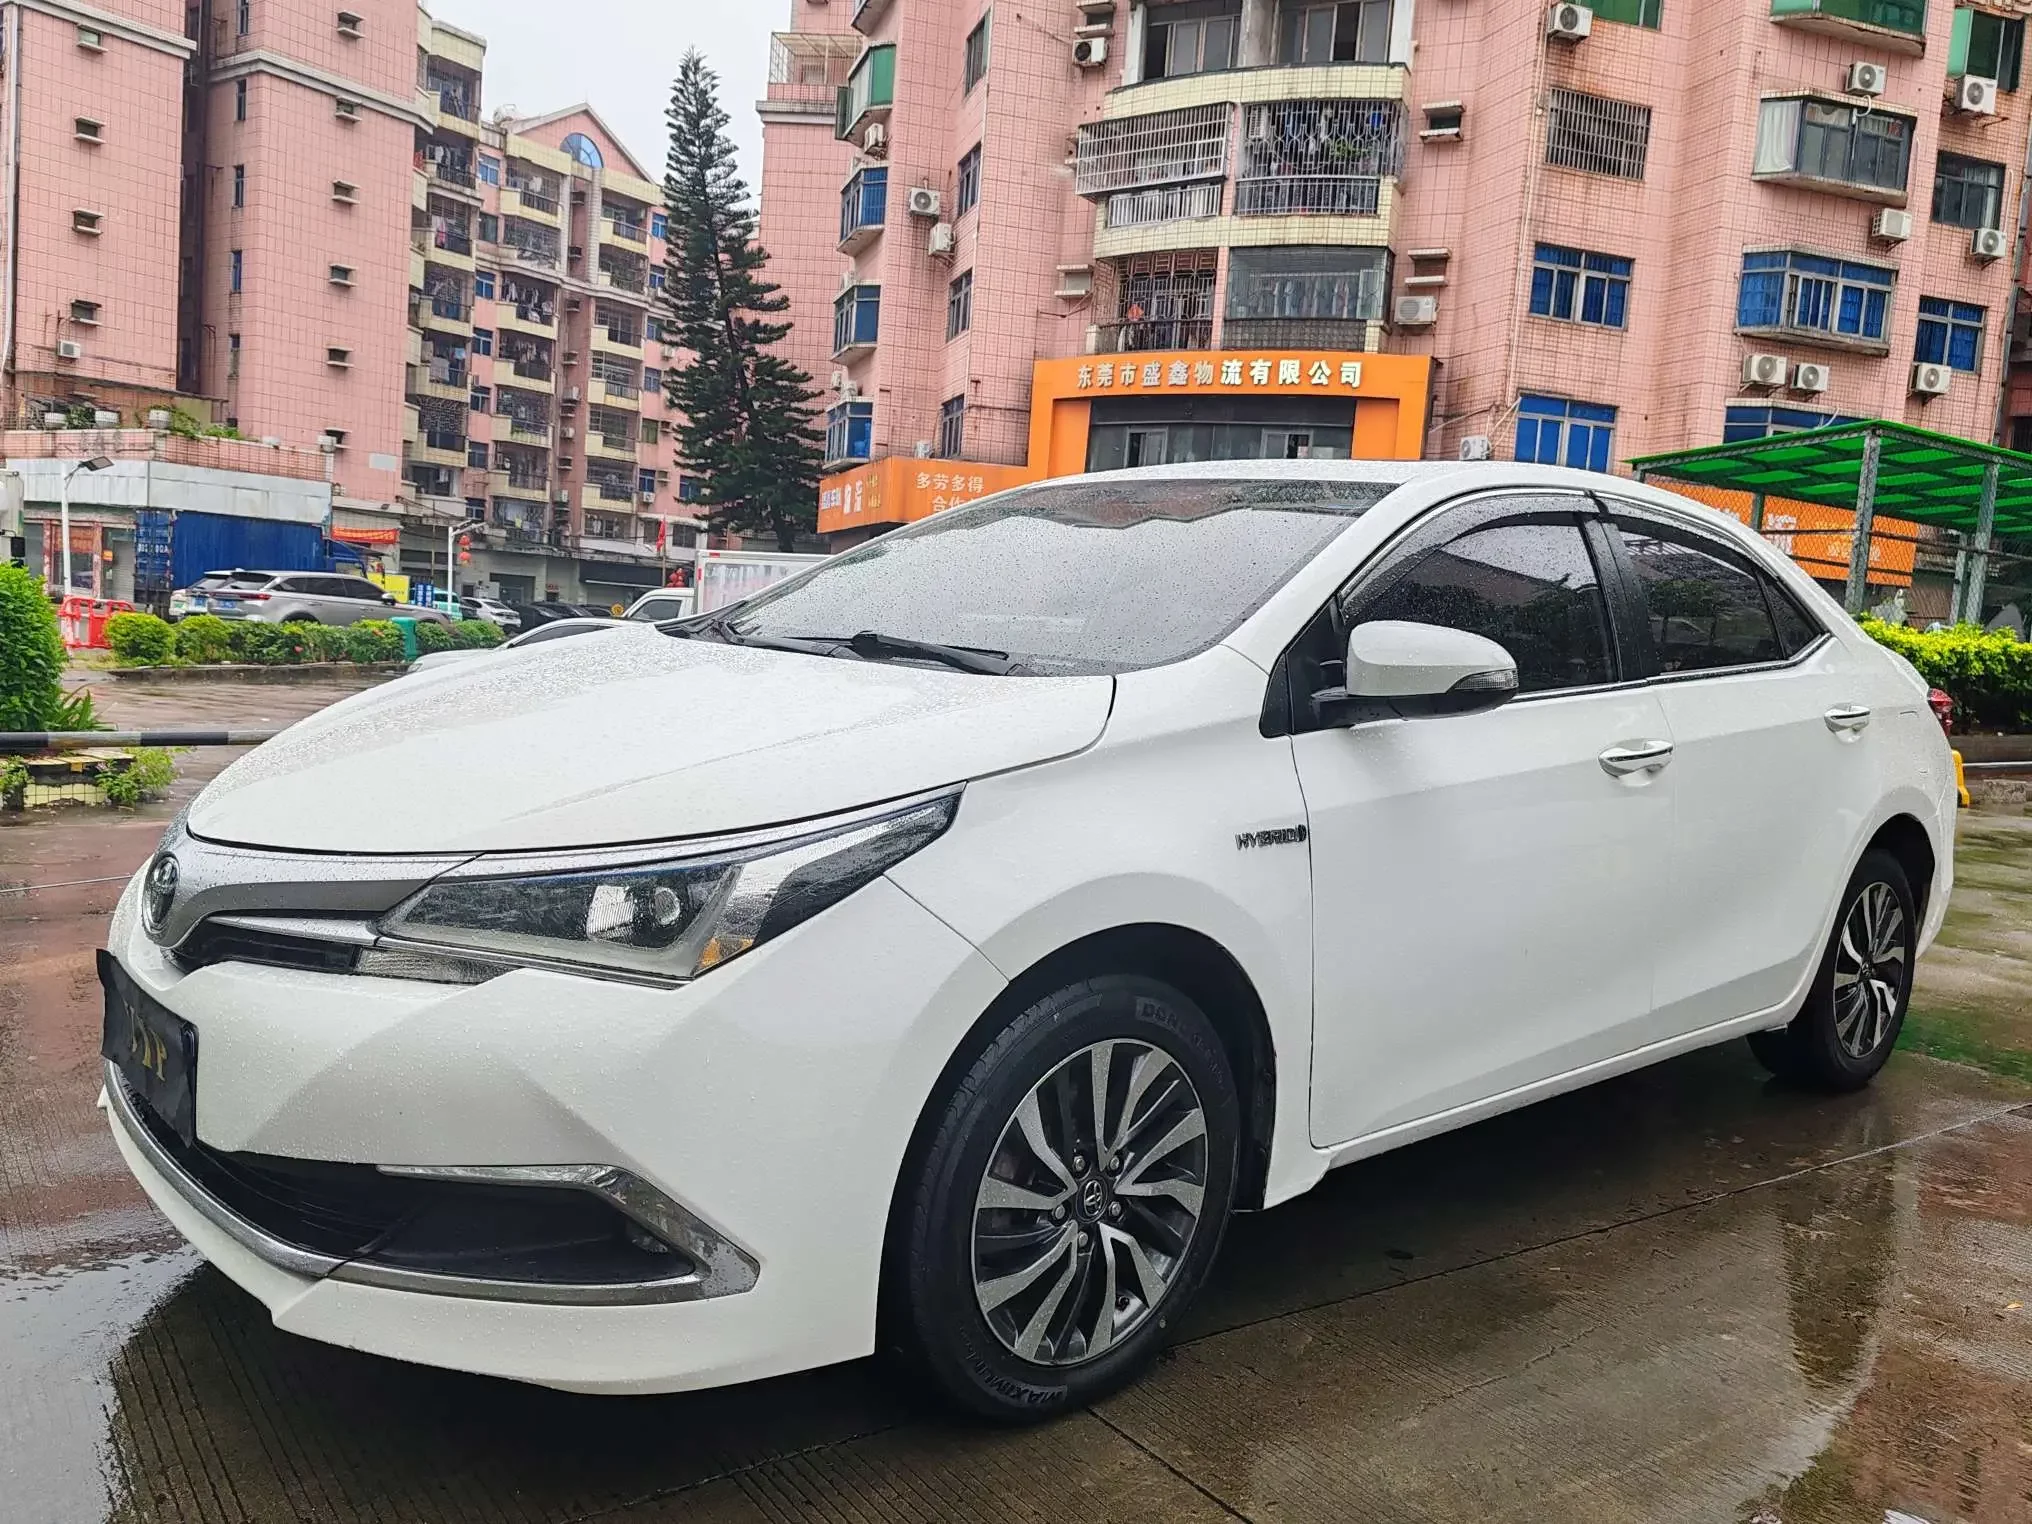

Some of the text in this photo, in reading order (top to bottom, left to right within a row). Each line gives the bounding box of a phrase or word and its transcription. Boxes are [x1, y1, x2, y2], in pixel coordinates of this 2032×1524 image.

[1076, 359, 1363, 389] 东莞市盛鑫物流有限公司
[916, 472, 985, 493] 多劳多得
[1234, 825, 1303, 850] HYBRID
